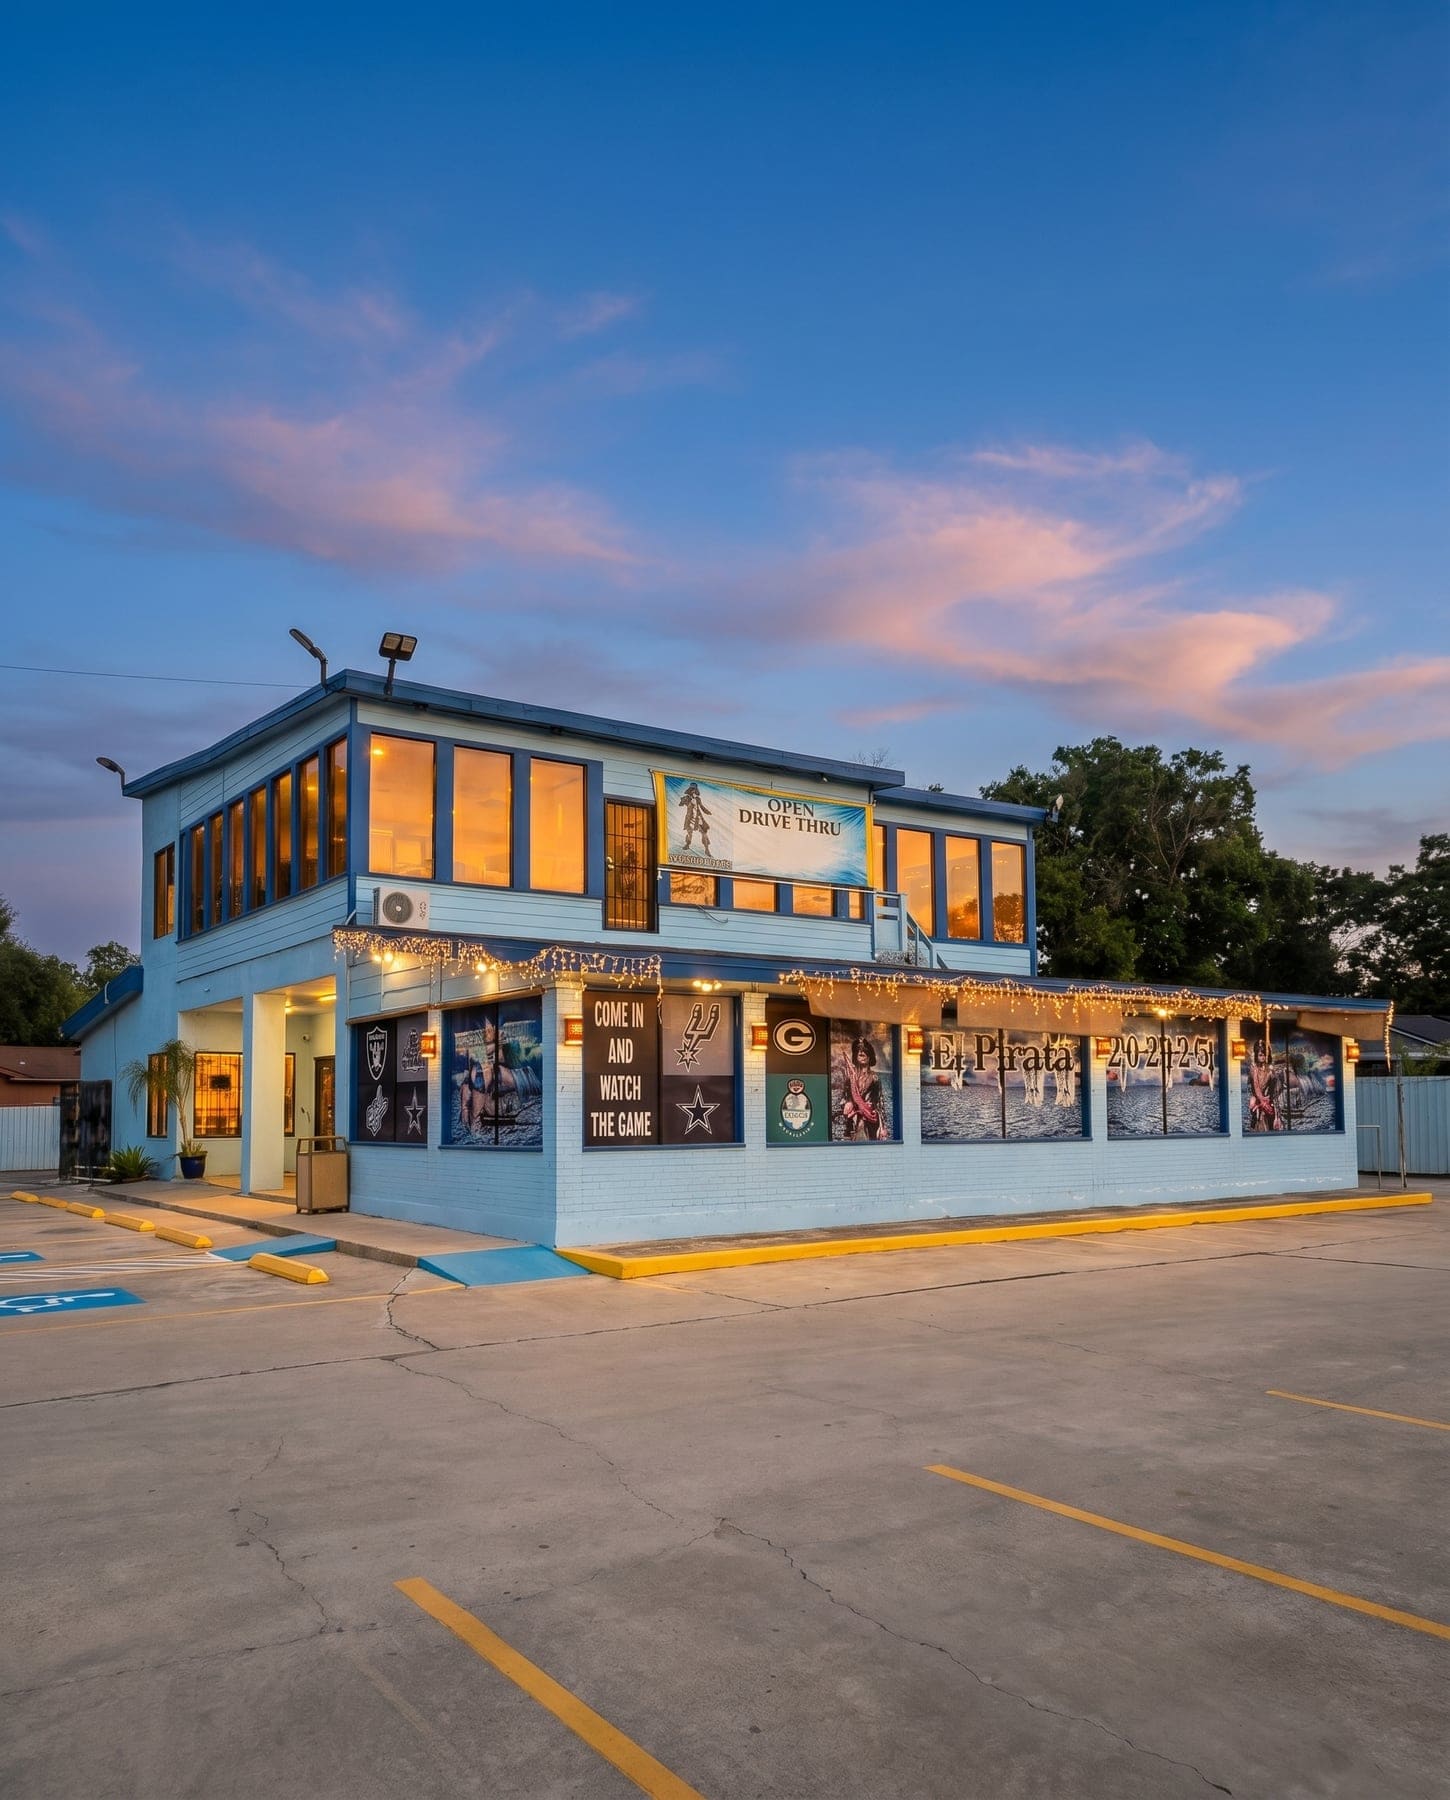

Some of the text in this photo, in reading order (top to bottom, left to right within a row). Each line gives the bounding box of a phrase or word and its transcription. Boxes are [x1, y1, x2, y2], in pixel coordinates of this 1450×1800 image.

[767, 798, 815, 817] OPEN
[739, 808, 842, 836] DRIVE THRU
[594, 1001, 644, 1028] COME IN
[608, 1038, 633, 1064] AND
[931, 1033, 965, 1071] El
[600, 1075, 641, 1101] WATCH
[591, 1111, 652, 1137] THE GAME
